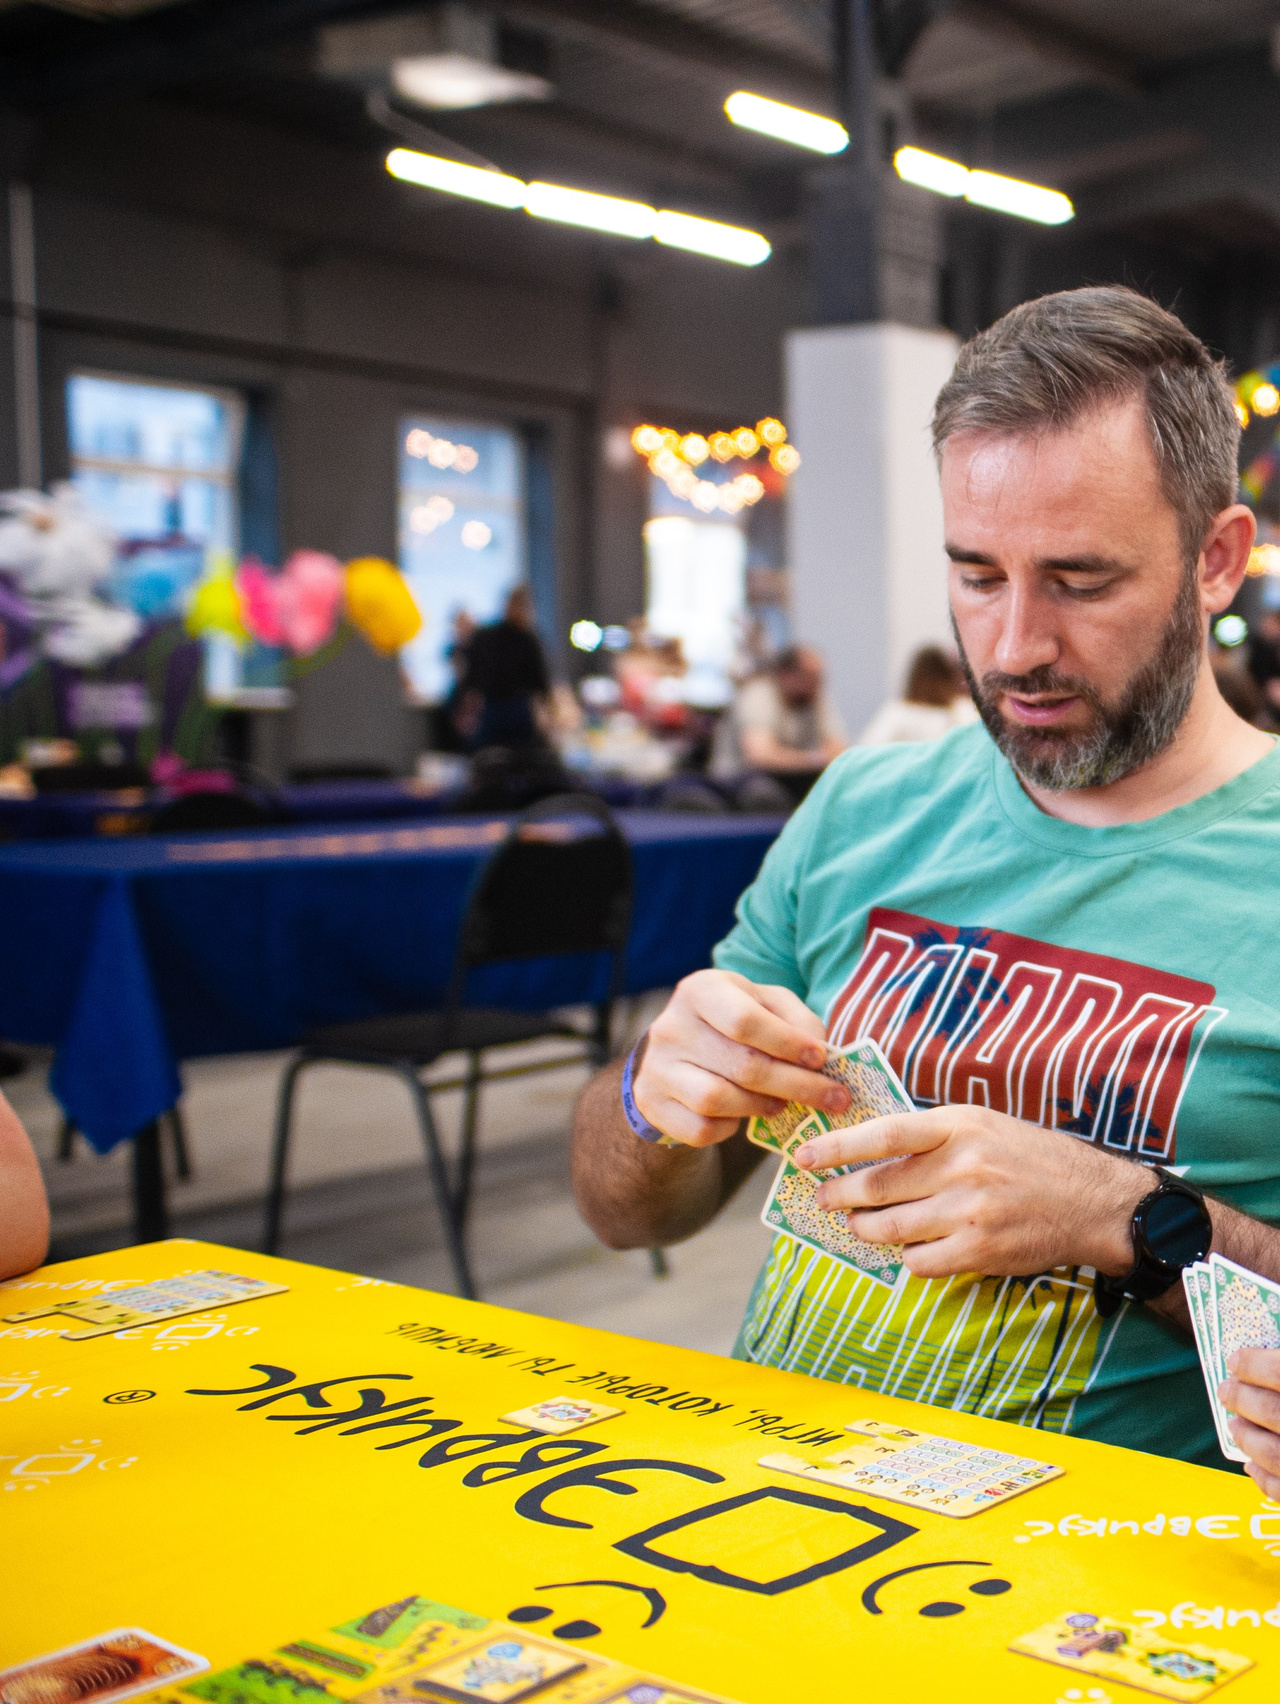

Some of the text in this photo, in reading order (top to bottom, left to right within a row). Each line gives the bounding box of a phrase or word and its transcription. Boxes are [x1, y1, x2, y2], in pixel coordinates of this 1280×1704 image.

[826, 927, 1229, 1160] MIAMI
[519, 1356, 575, 1377] ТЫ
[565, 1370, 734, 1417] КОТОРЫЕ
[733, 1409, 846, 1447] ИГРЫ,
